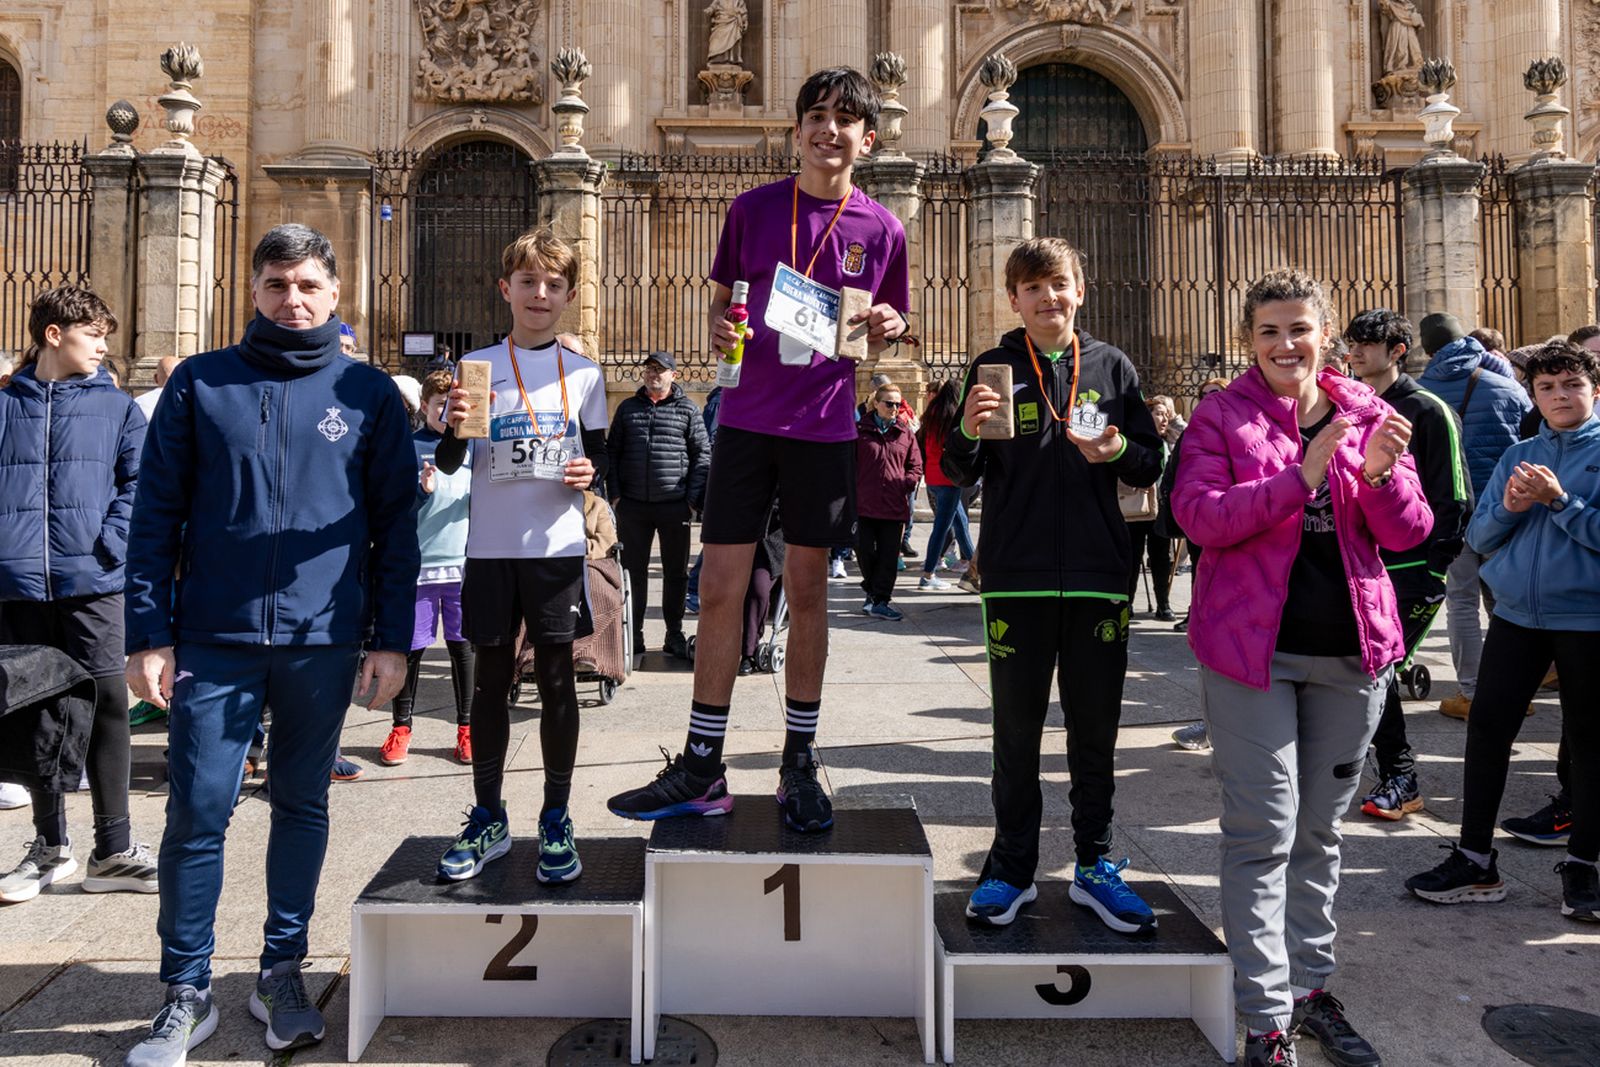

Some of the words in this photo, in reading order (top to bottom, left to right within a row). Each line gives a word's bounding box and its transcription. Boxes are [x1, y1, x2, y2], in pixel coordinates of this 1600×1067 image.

[782, 283, 803, 300] BUENA
[803, 293, 829, 313] MUERTE
[795, 306, 818, 332] 61
[500, 426, 525, 438] BUENA
[763, 864, 801, 941] 1
[483, 914, 538, 981] 2
[1035, 965, 1092, 1006] 3
